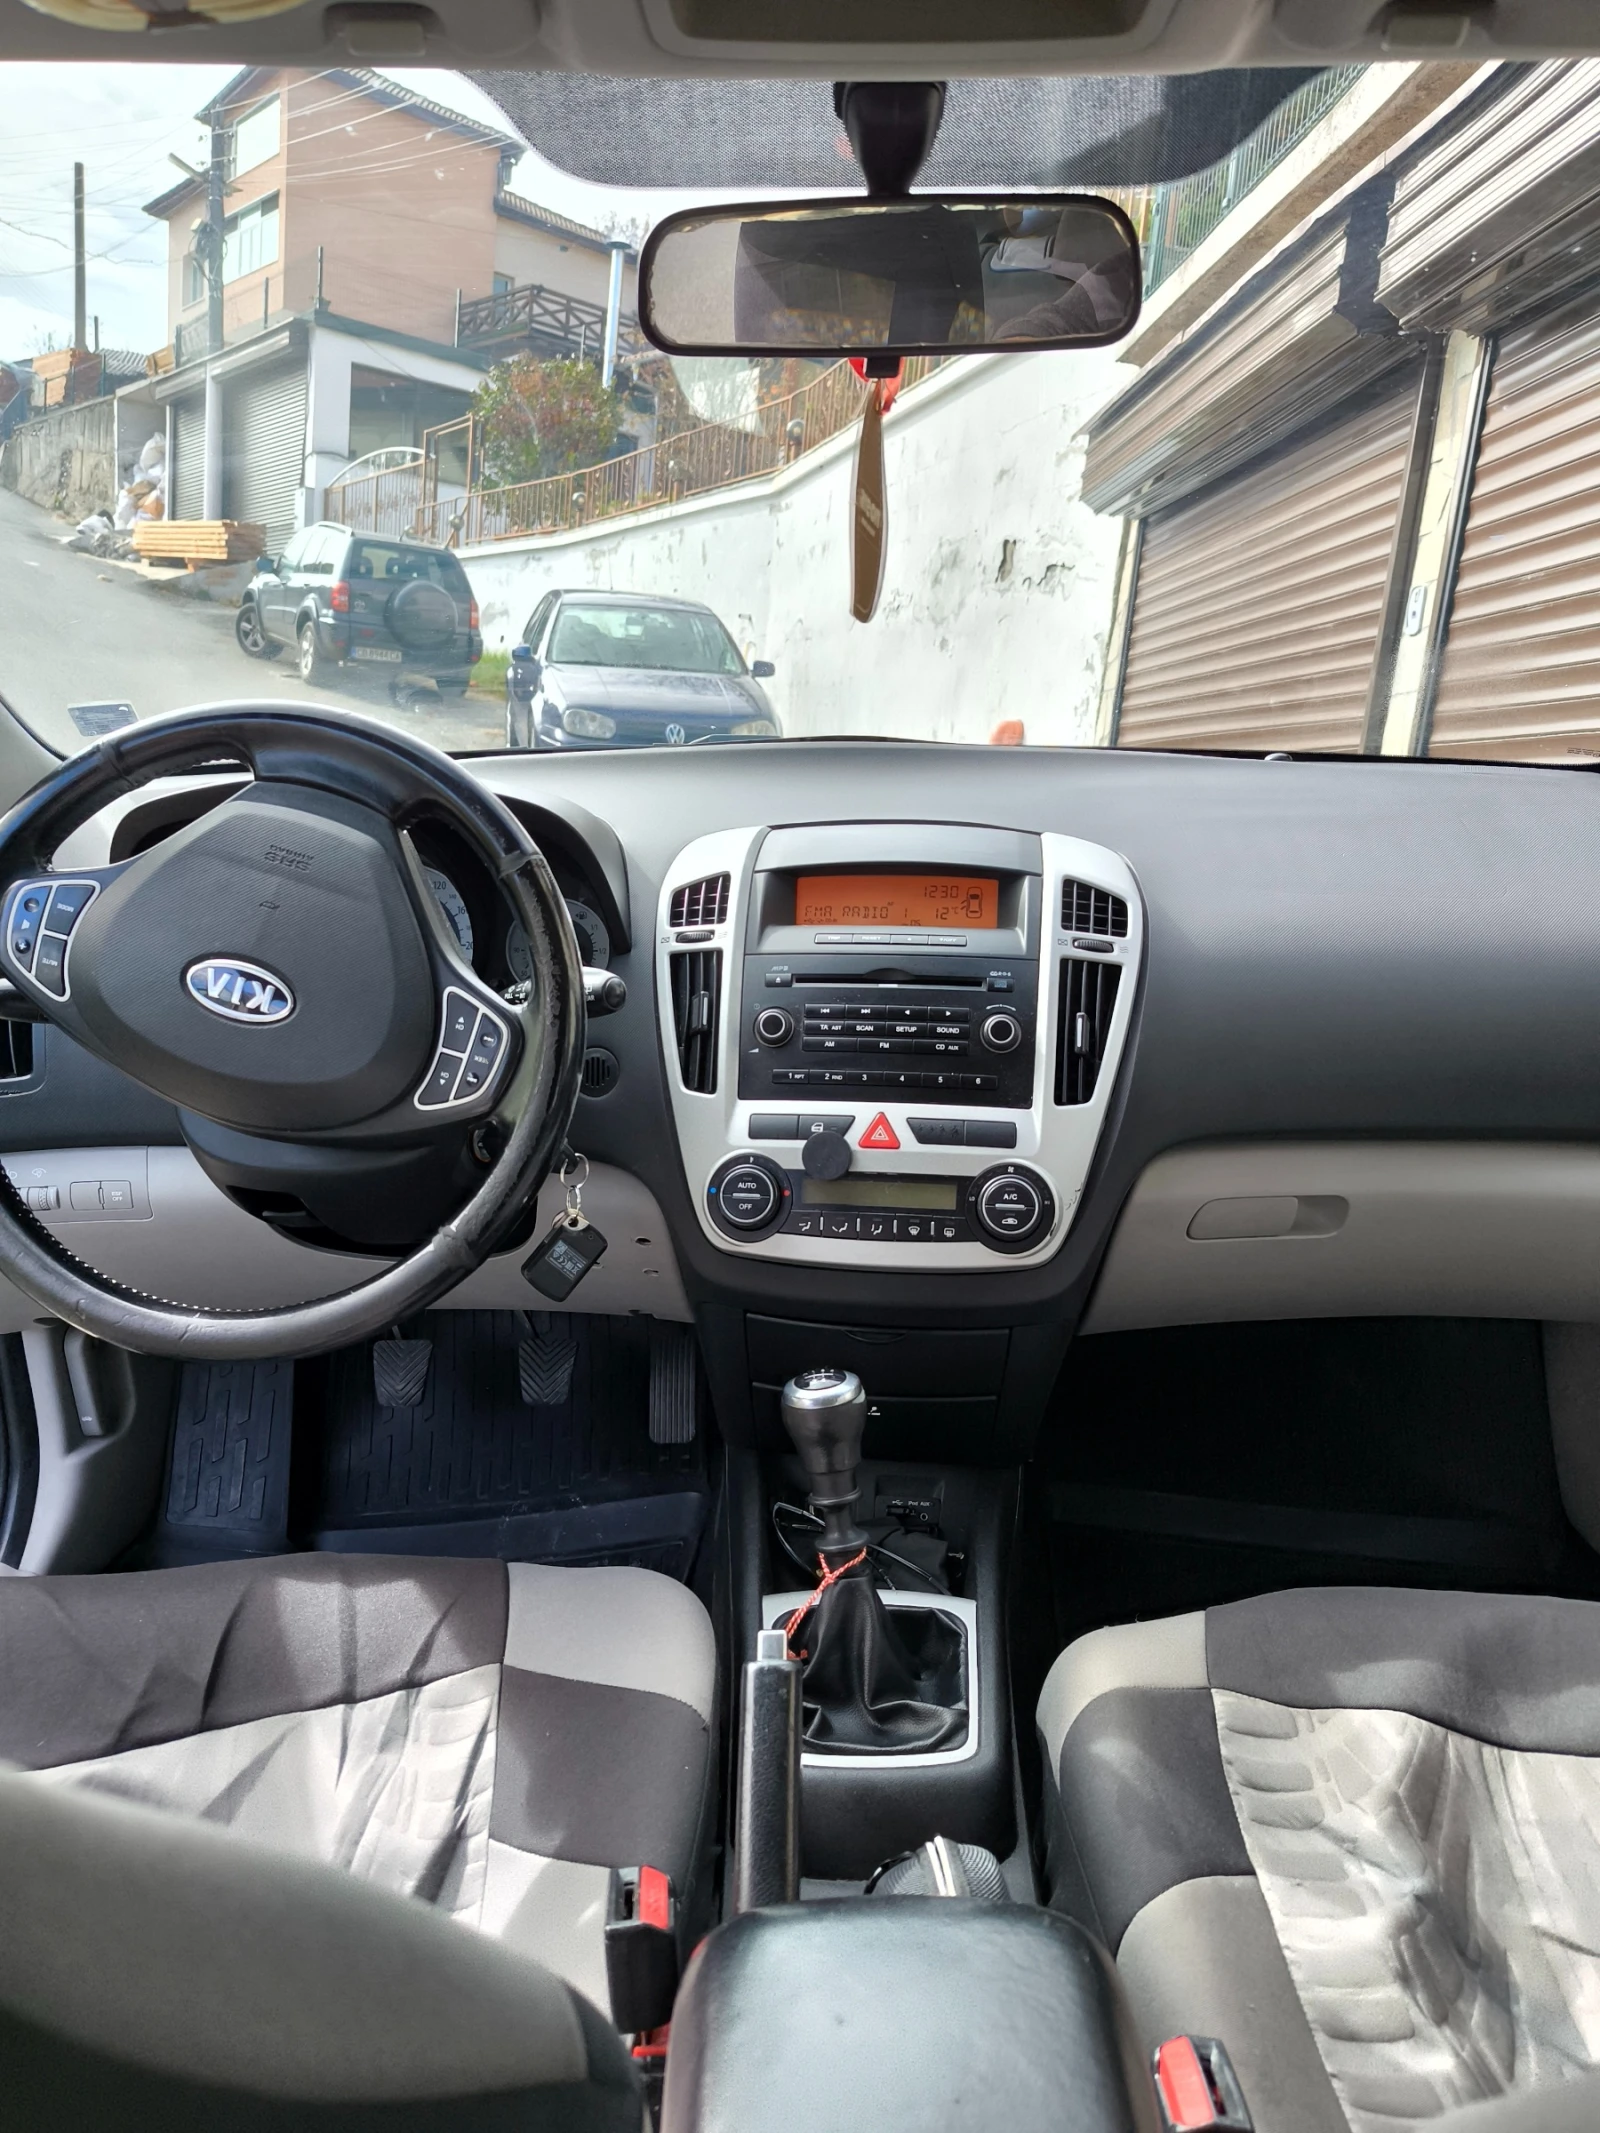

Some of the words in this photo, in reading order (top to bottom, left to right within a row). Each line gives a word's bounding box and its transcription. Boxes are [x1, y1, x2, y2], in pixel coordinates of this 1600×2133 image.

[206, 967, 276, 1014] KIA
[895, 1025, 917, 1033] SETUP
[936, 1026, 960, 1035] SOUND
[824, 1040, 835, 1048] AM
[879, 1041, 890, 1049] FM
[935, 1043, 946, 1051] CD
[824, 1073, 830, 1081] 2
[861, 1073, 868, 1082] 3
[899, 1074, 905, 1083] 4
[937, 1075, 944, 1084] 5
[975, 1077, 982, 1085] 6
[737, 1181, 758, 1190] AUTO
[1002, 1192, 1019, 1202] A/C
[738, 1202, 753, 1211] OFF
